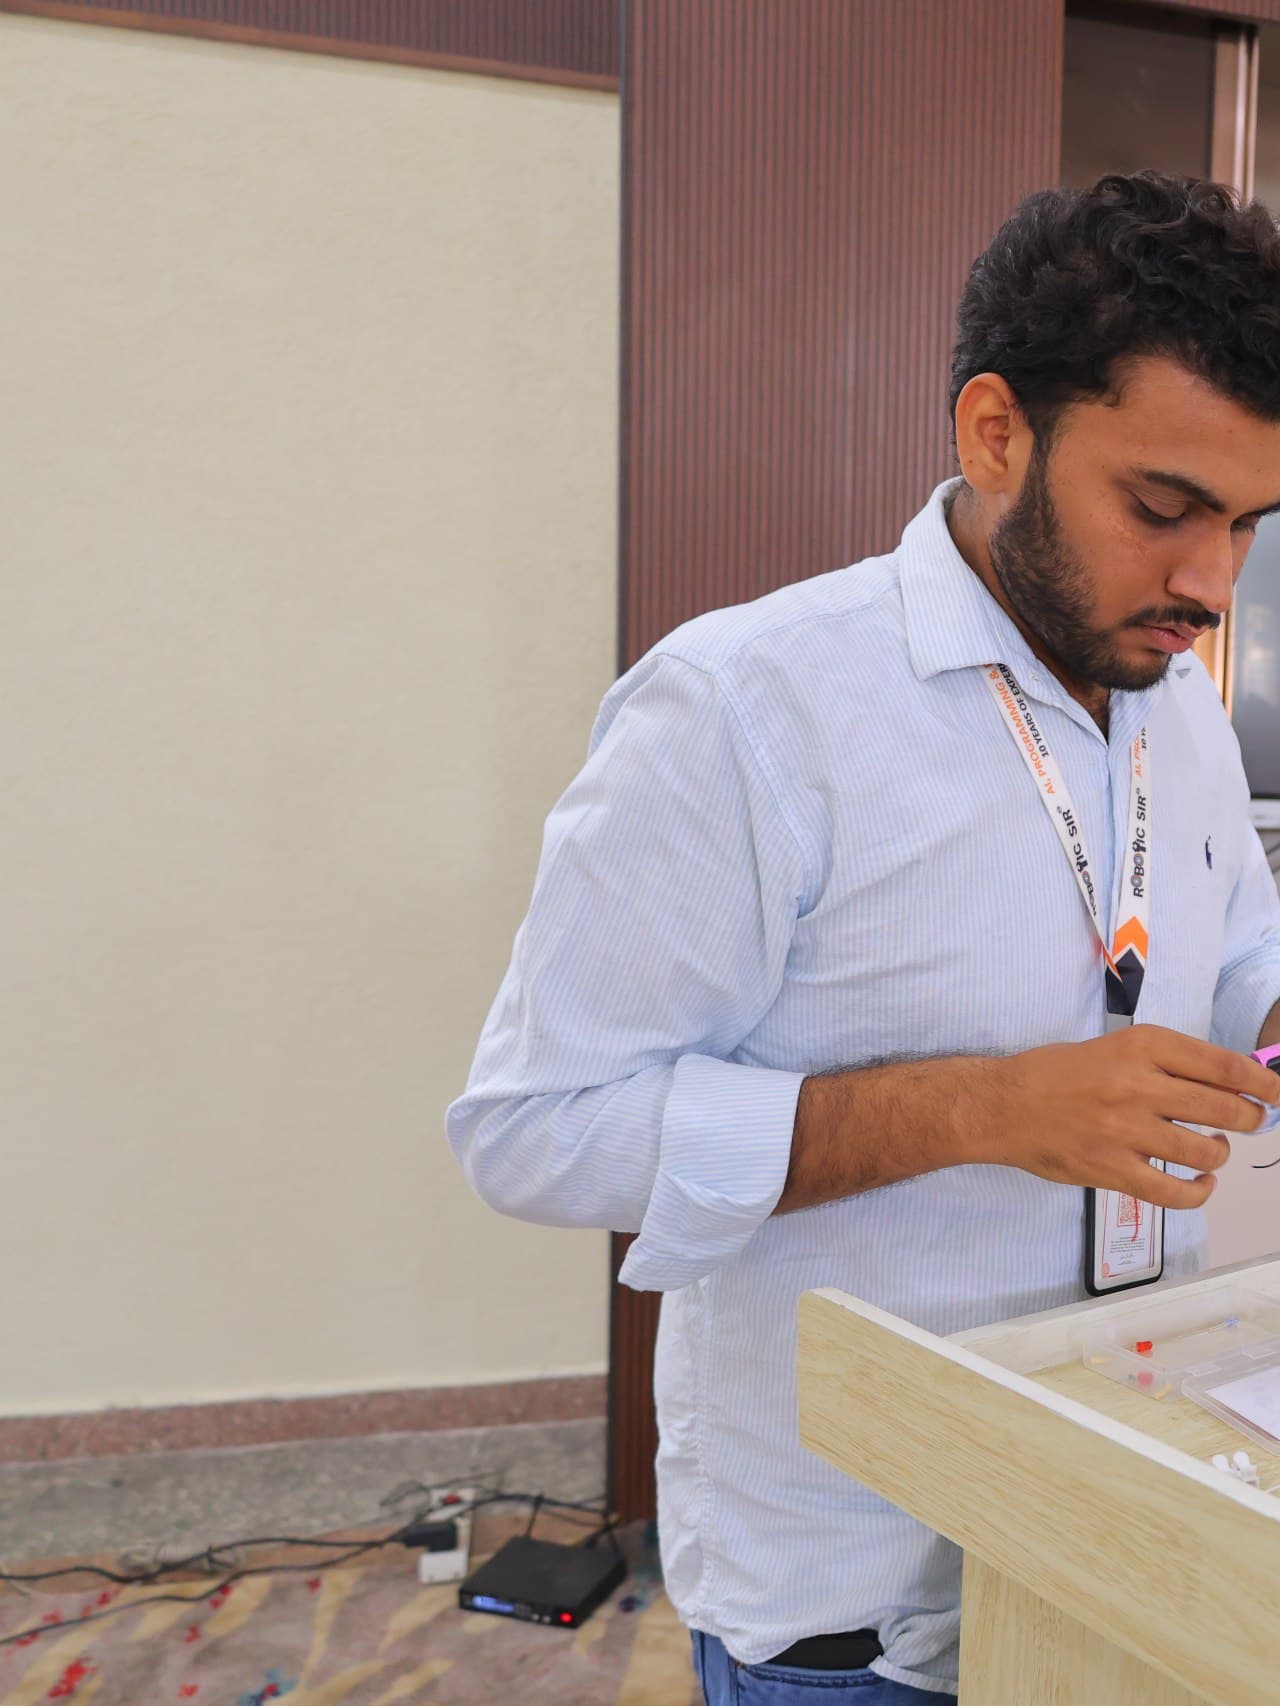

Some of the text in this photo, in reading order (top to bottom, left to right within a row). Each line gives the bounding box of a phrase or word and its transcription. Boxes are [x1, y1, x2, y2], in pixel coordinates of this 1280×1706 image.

[1016, 698, 1028, 711] OF
[995, 681, 1047, 778] PROGRAMMING
[1024, 712, 1043, 745] YEARS
[1038, 745, 1050, 758] 10
[1130, 827, 1147, 898] ROBOTIC
